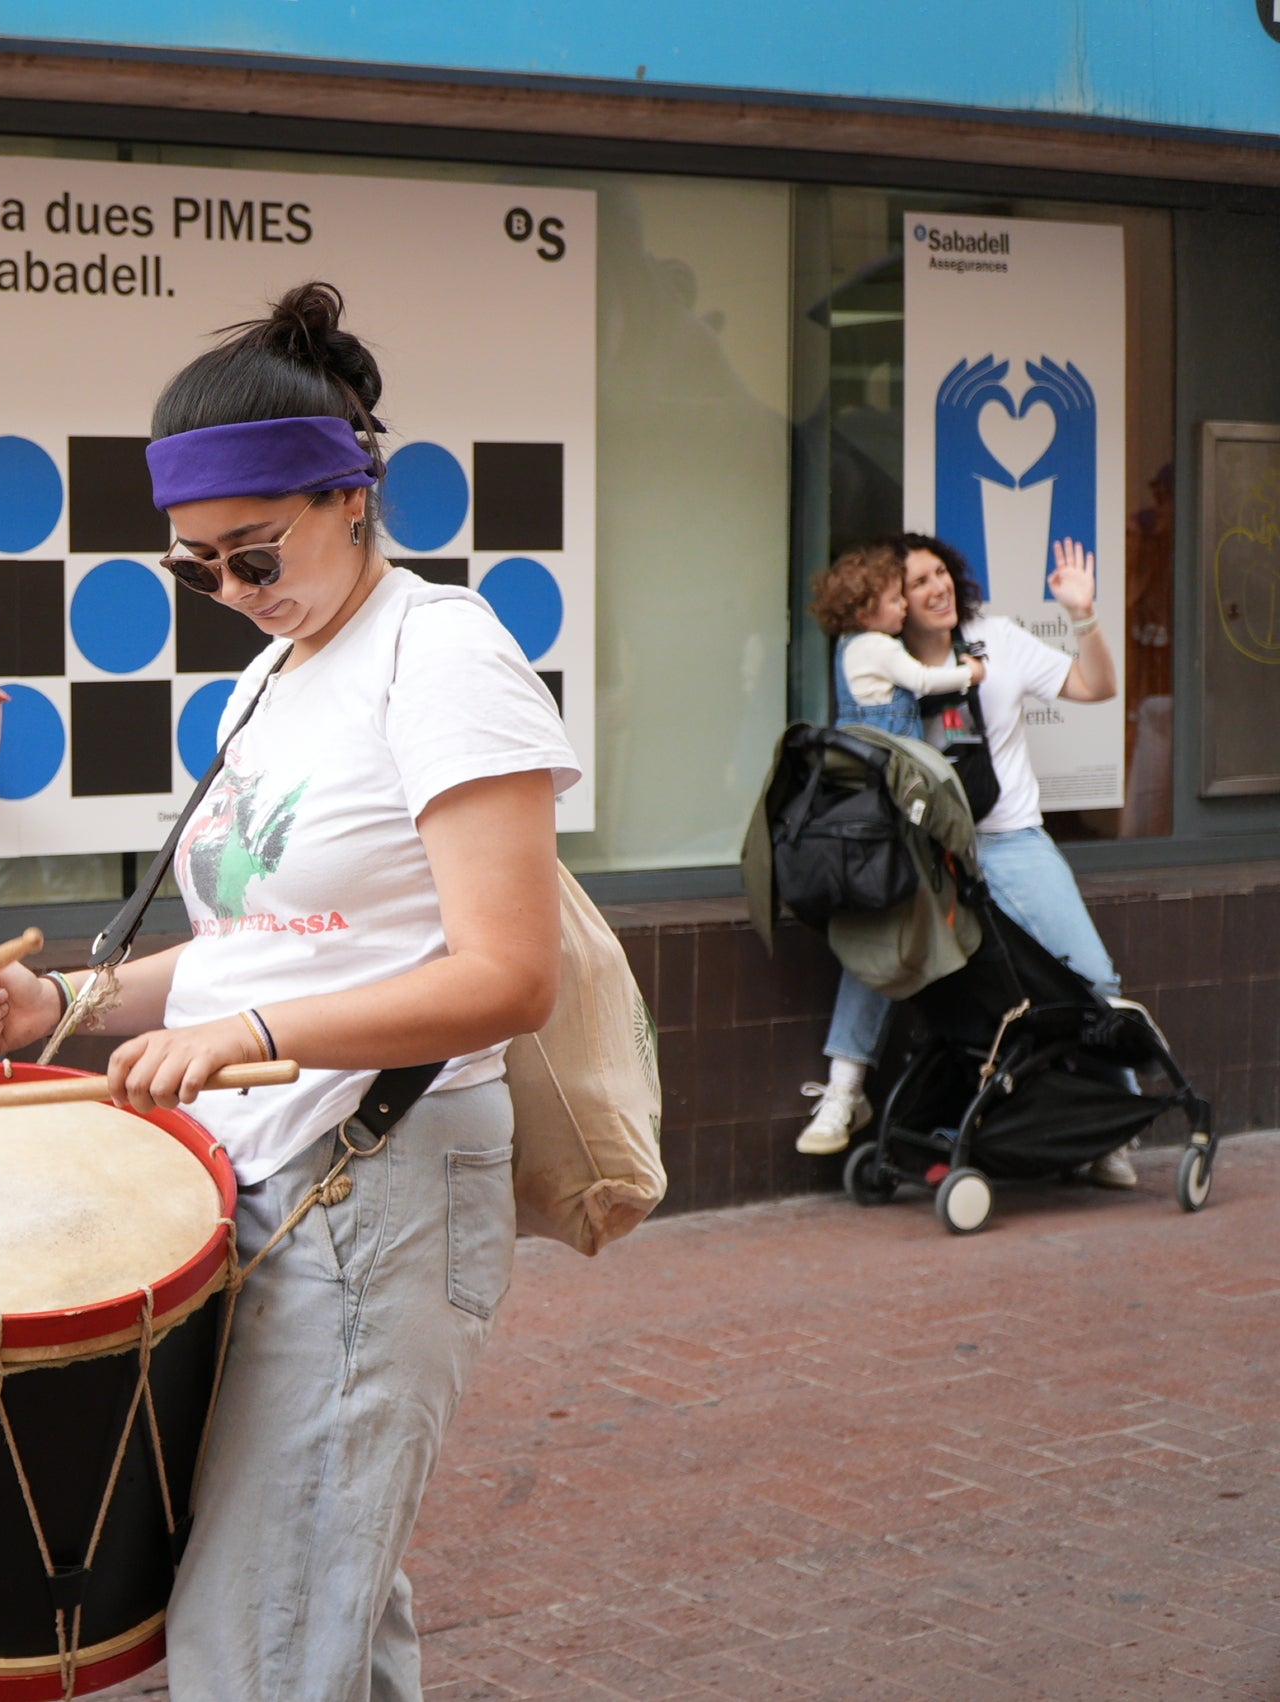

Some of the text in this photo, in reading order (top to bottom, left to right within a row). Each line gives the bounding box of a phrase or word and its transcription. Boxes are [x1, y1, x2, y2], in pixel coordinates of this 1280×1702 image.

[44, 191, 155, 239] dues
[173, 196, 313, 245] PIMES
[928, 229, 1010, 256] Sabadell
[928, 256, 1009, 274] Assegurances
[1022, 707, 1065, 726] ents.
